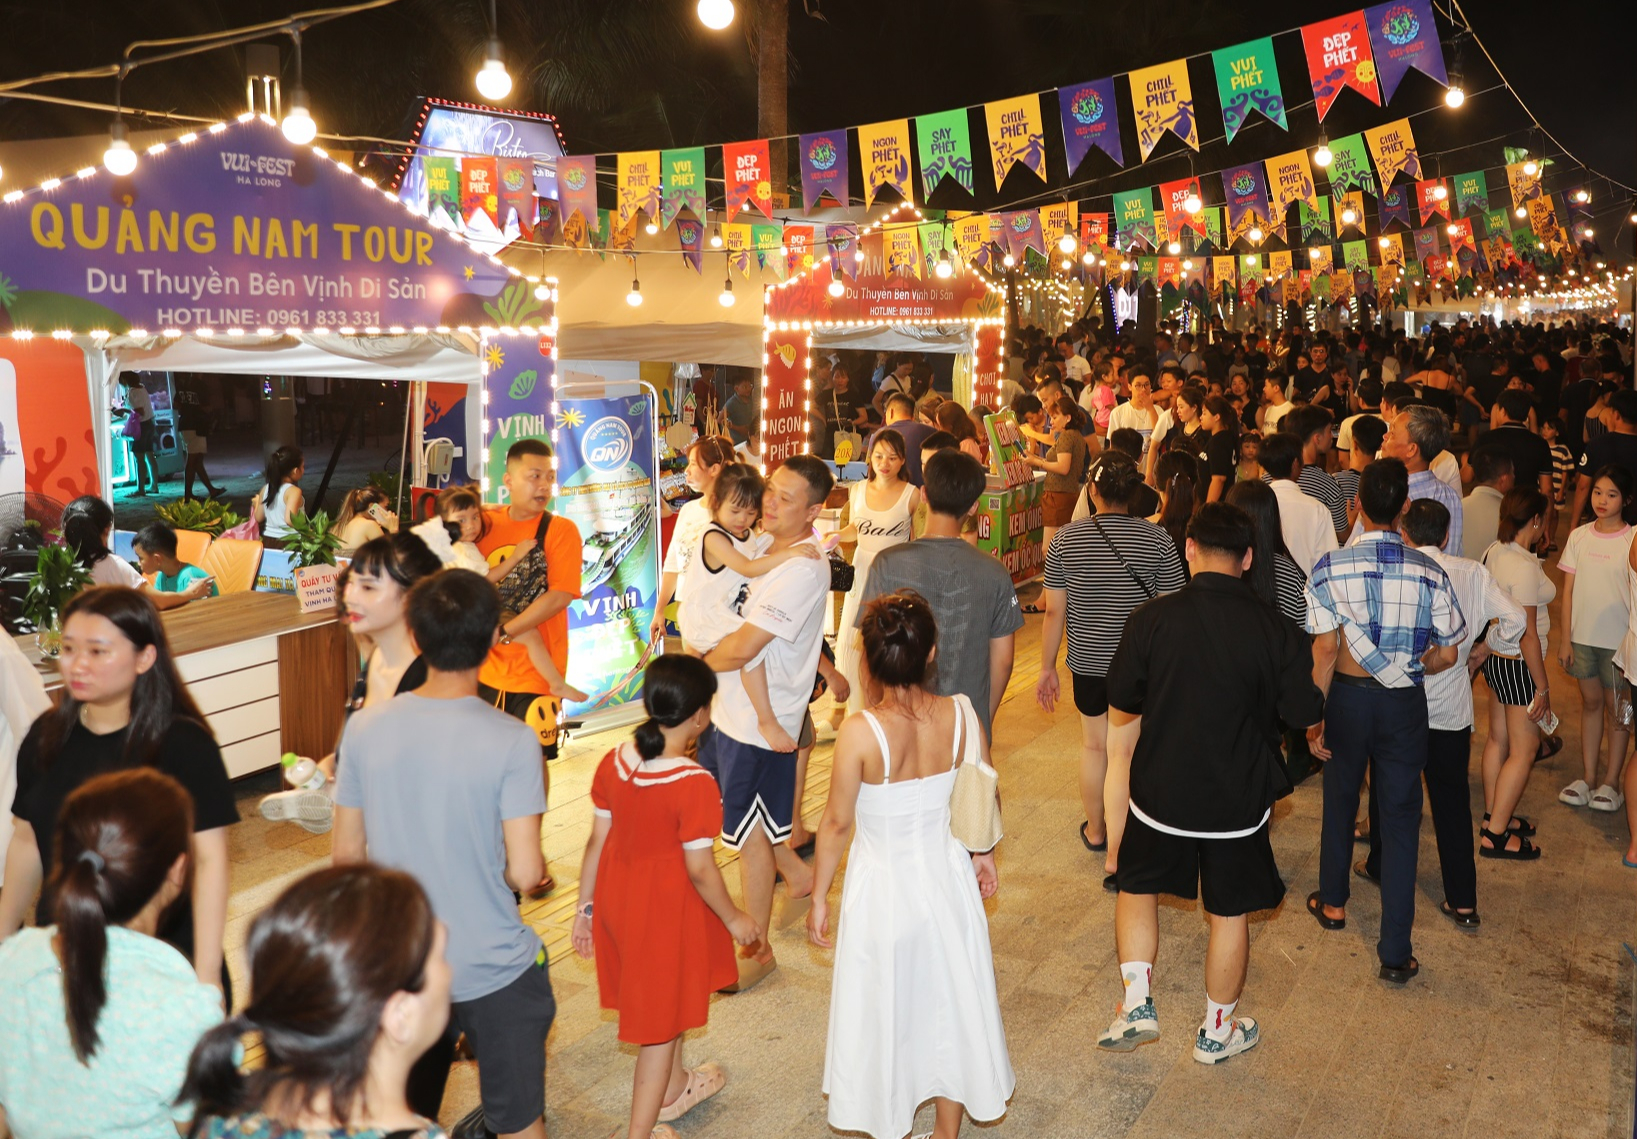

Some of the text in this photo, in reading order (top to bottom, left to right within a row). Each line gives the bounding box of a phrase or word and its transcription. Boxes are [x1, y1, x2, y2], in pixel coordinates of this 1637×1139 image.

[1230, 56, 1257, 74] VUI
[1146, 74, 1174, 92] CHILL
[1001, 108, 1027, 124] CHILL
[482, 121, 530, 159] Bistro
[872, 136, 897, 148] NGON
[932, 128, 952, 143] SAY
[1380, 130, 1401, 145] CHILL
[1334, 149, 1351, 162] SAY
[221, 152, 295, 177] VUI-FEST
[629, 162, 649, 174] CHILL
[673, 160, 693, 174] VUI
[1278, 163, 1300, 176] NGON
[432, 168, 447, 178] VUI
[545, 169, 556, 178] Bar
[255, 177, 282, 188] LONG
[1463, 178, 1476, 188] VUI
[1125, 199, 1142, 210] VUI
[31, 194, 434, 266] QUẢNG NAM TOUR
[928, 230, 942, 240] SAY
[760, 234, 773, 242] VUI
[87, 265, 426, 303] Du Thuyền Bên Vịnh Di Sản
[846, 287, 858, 300] Du
[861, 286, 892, 302] Thuyền
[912, 288, 928, 302] Vịnh
[930, 288, 940, 300] Di
[157, 308, 380, 326] HOTLINE: 0961 833 331
[870, 306, 933, 316] HOTLINE: 0961 833 331
[778, 388, 794, 410] ĂN
[770, 416, 802, 436] NGON
[770, 436, 800, 462] PHẾT
[835, 448, 852, 458] 20K
[1009, 511, 1026, 537] KEM
[1022, 541, 1031, 569] ỐC
[306, 588, 324, 597] THAM
